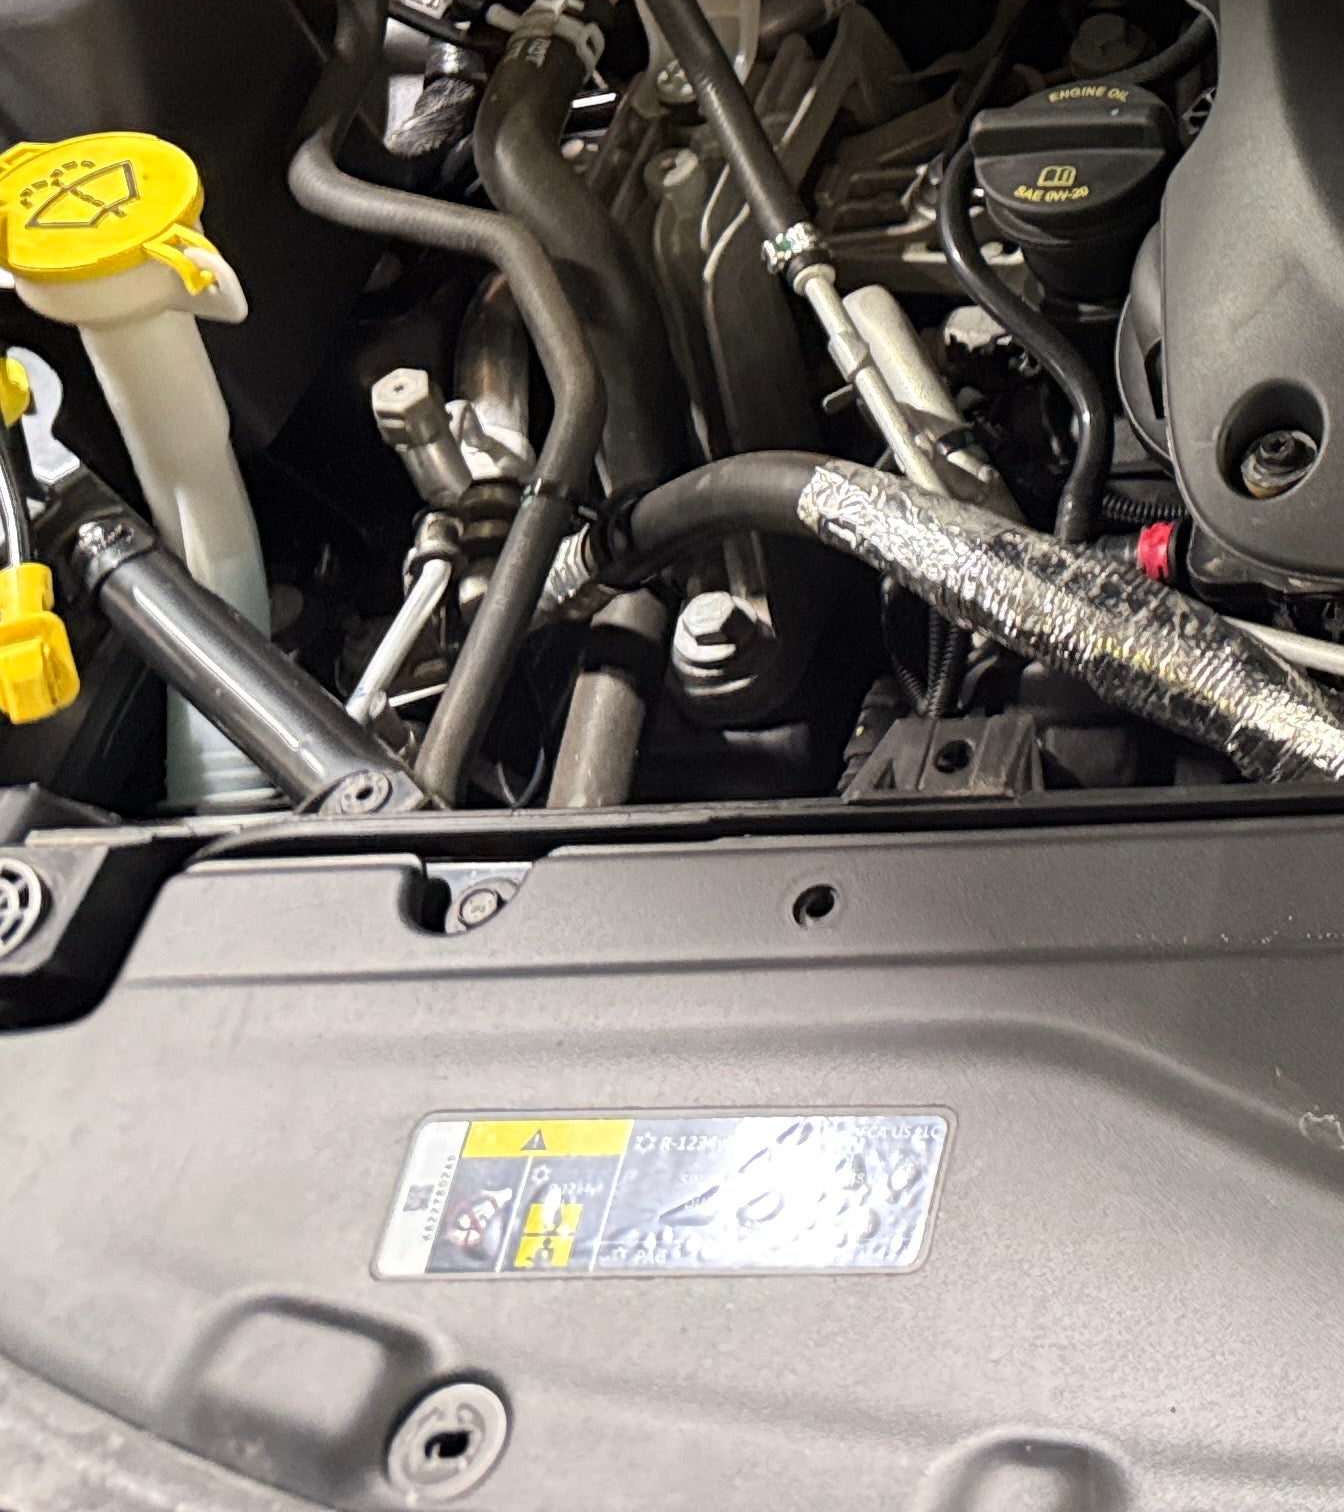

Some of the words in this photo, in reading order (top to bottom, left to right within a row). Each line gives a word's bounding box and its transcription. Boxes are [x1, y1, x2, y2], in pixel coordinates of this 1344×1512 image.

[1048, 86, 1107, 103] ENGINE
[1107, 88, 1129, 102] OIL
[1014, 185, 1044, 202] SAE
[1044, 186, 1090, 202] 0W-20
